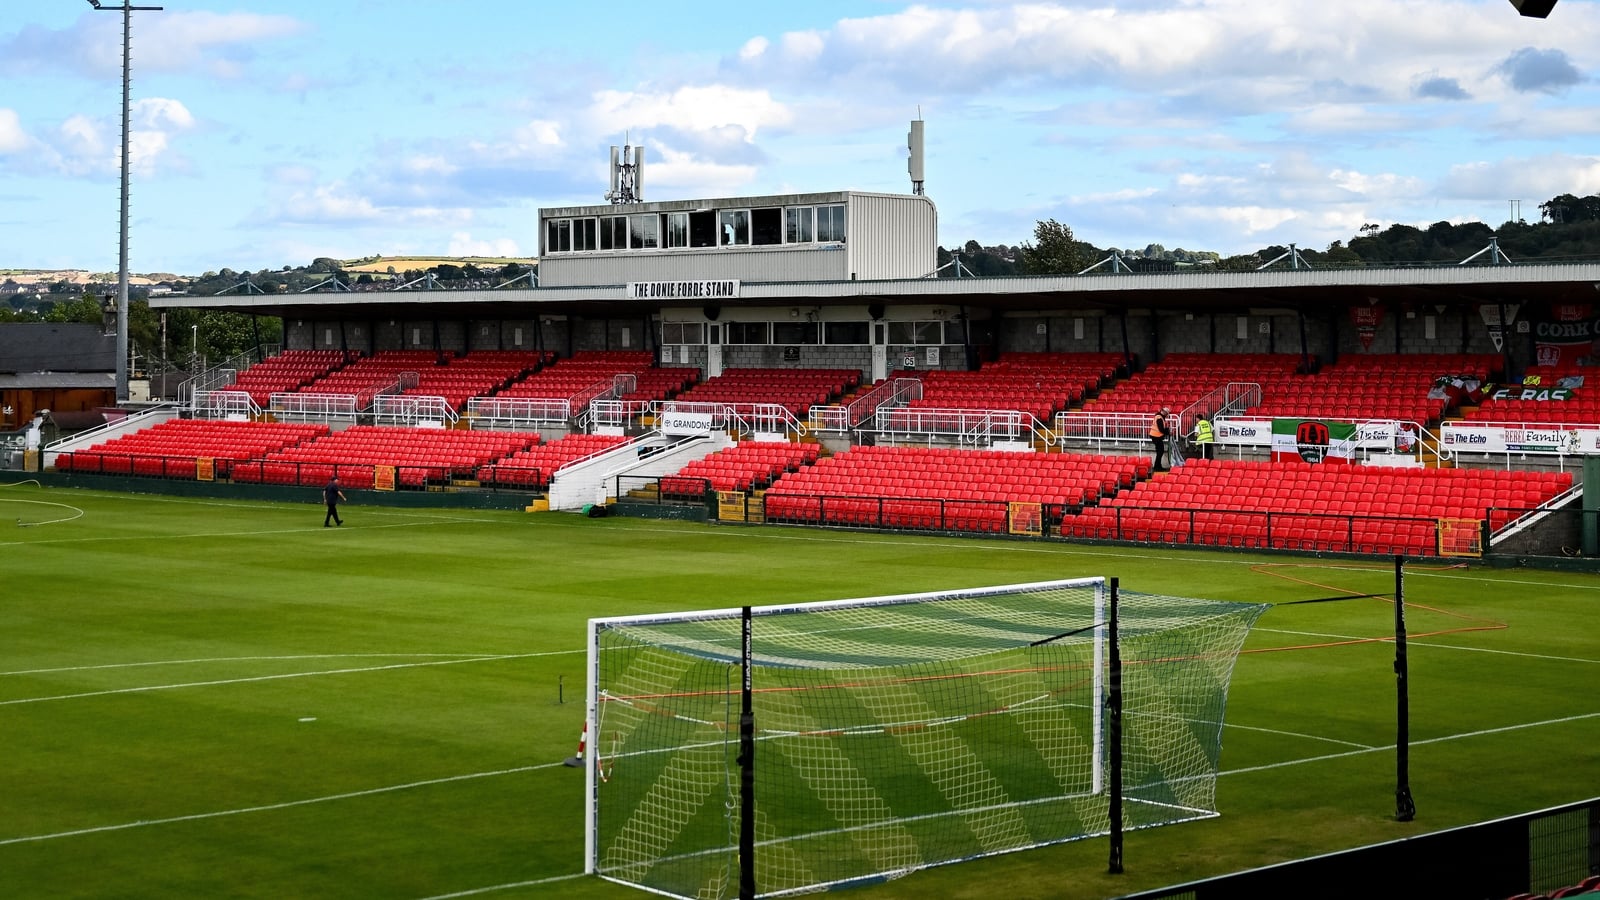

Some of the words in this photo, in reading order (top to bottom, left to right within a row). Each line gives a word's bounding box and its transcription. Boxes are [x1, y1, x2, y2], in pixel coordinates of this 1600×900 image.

[635, 283, 648, 297] THE
[650, 283, 675, 297] DONIE
[678, 282, 703, 297] FORDE
[706, 281, 734, 296] STAND
[1536, 321, 1590, 337] CORK
[904, 357, 914, 366] C5
[672, 419, 710, 430] GRANDONS
[1229, 427, 1240, 437] The
[1241, 427, 1257, 437] Echo
[1455, 433, 1468, 443] The
[1469, 434, 1487, 444] Echo
[1504, 430, 1526, 443] REBEL
[1526, 430, 1567, 447] Family
